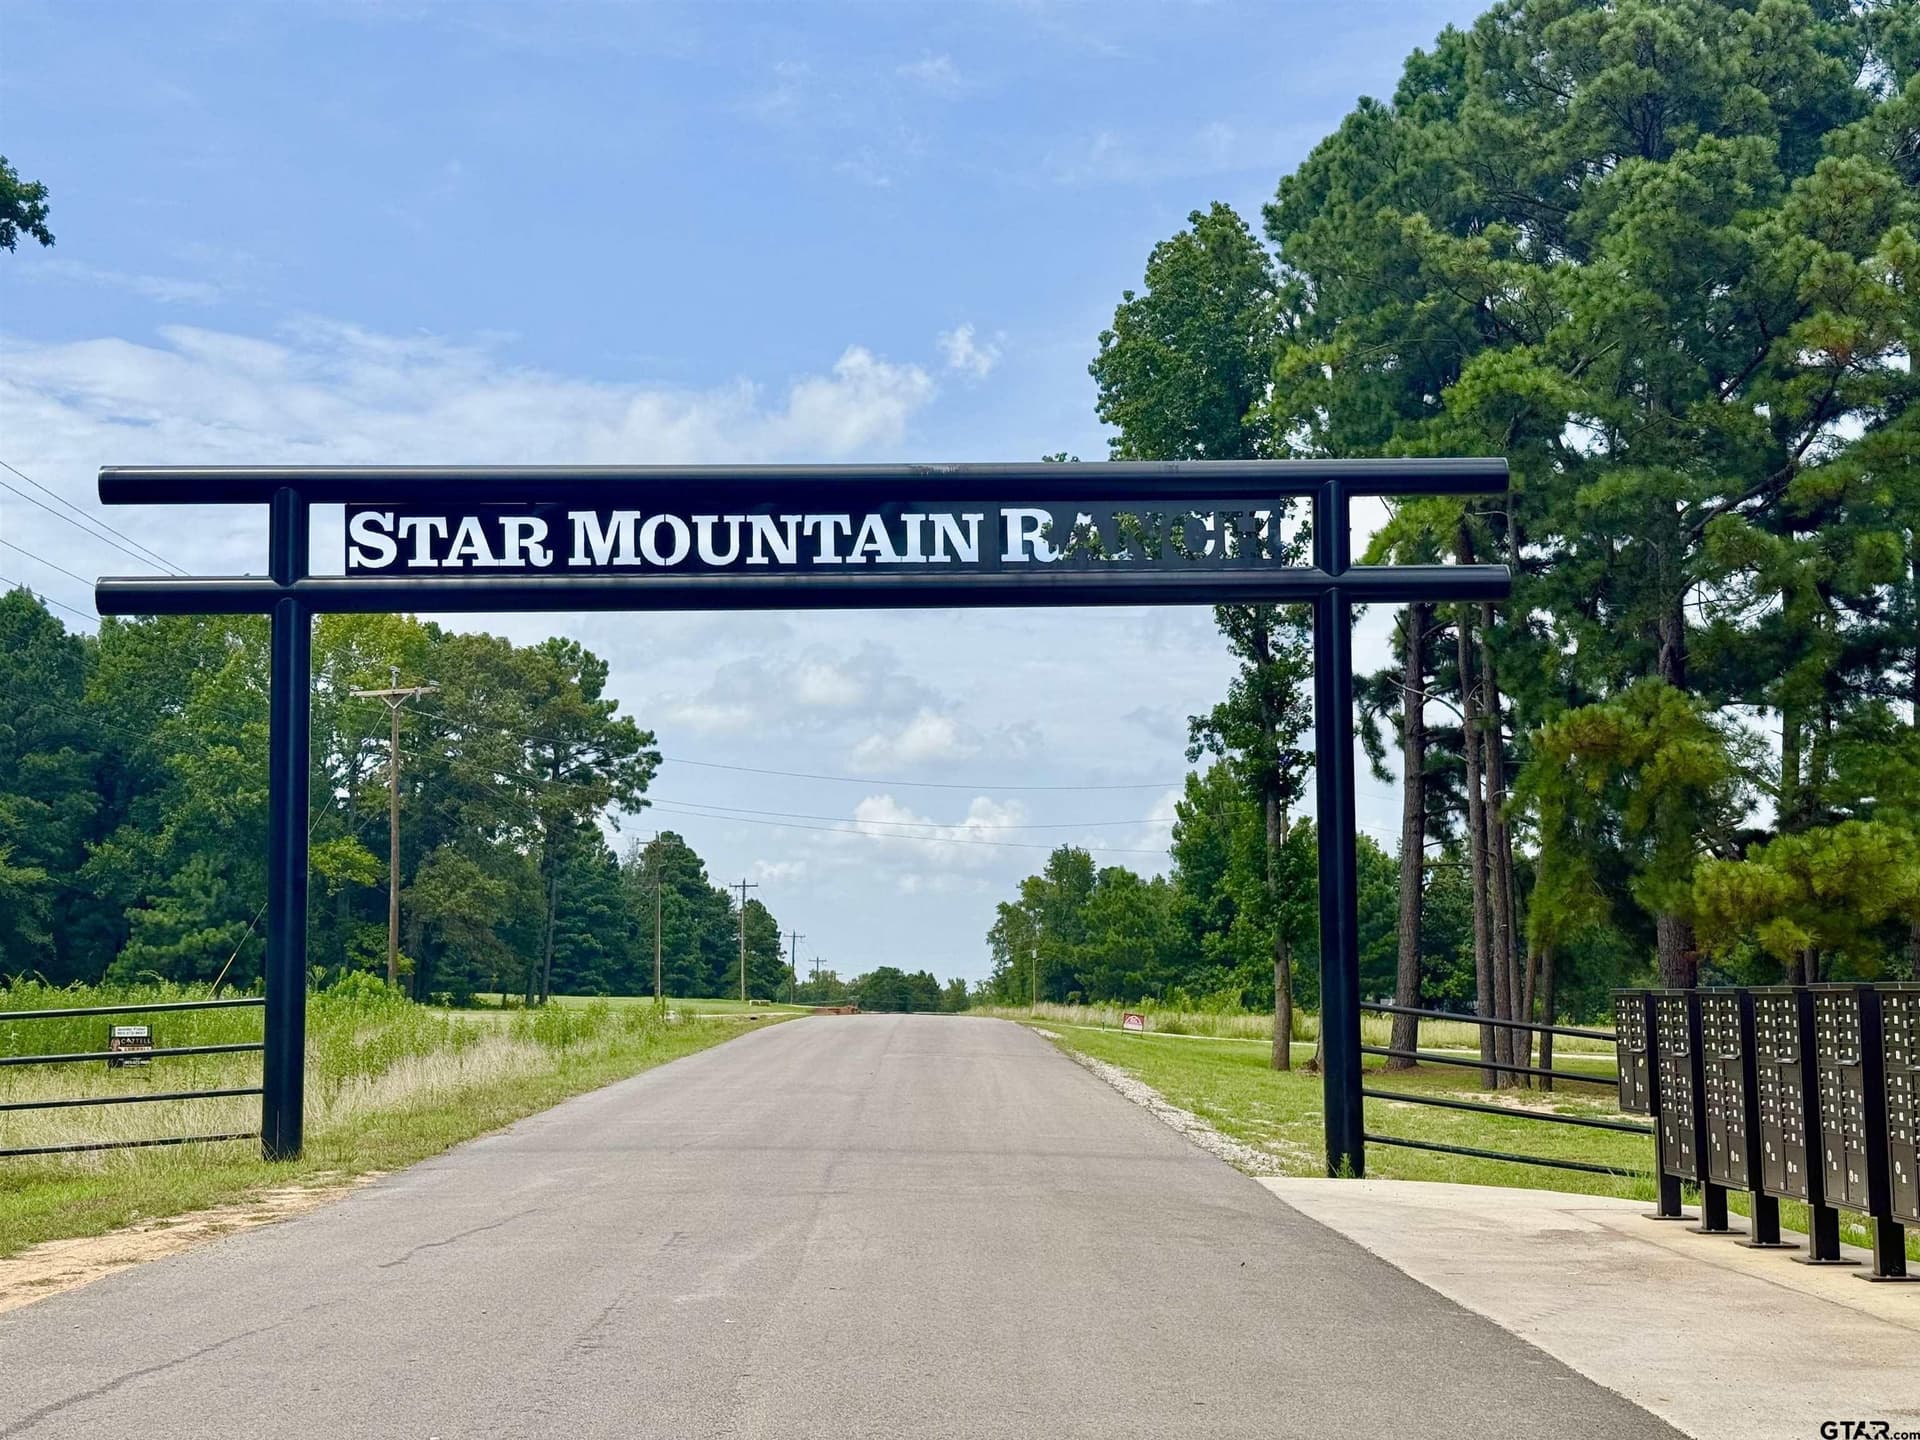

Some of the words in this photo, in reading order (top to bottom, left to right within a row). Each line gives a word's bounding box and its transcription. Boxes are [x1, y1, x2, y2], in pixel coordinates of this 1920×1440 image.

[348, 511, 553, 568] STAR
[567, 510, 984, 567] MOUNTAIN
[1000, 507, 1275, 564] RANCH
